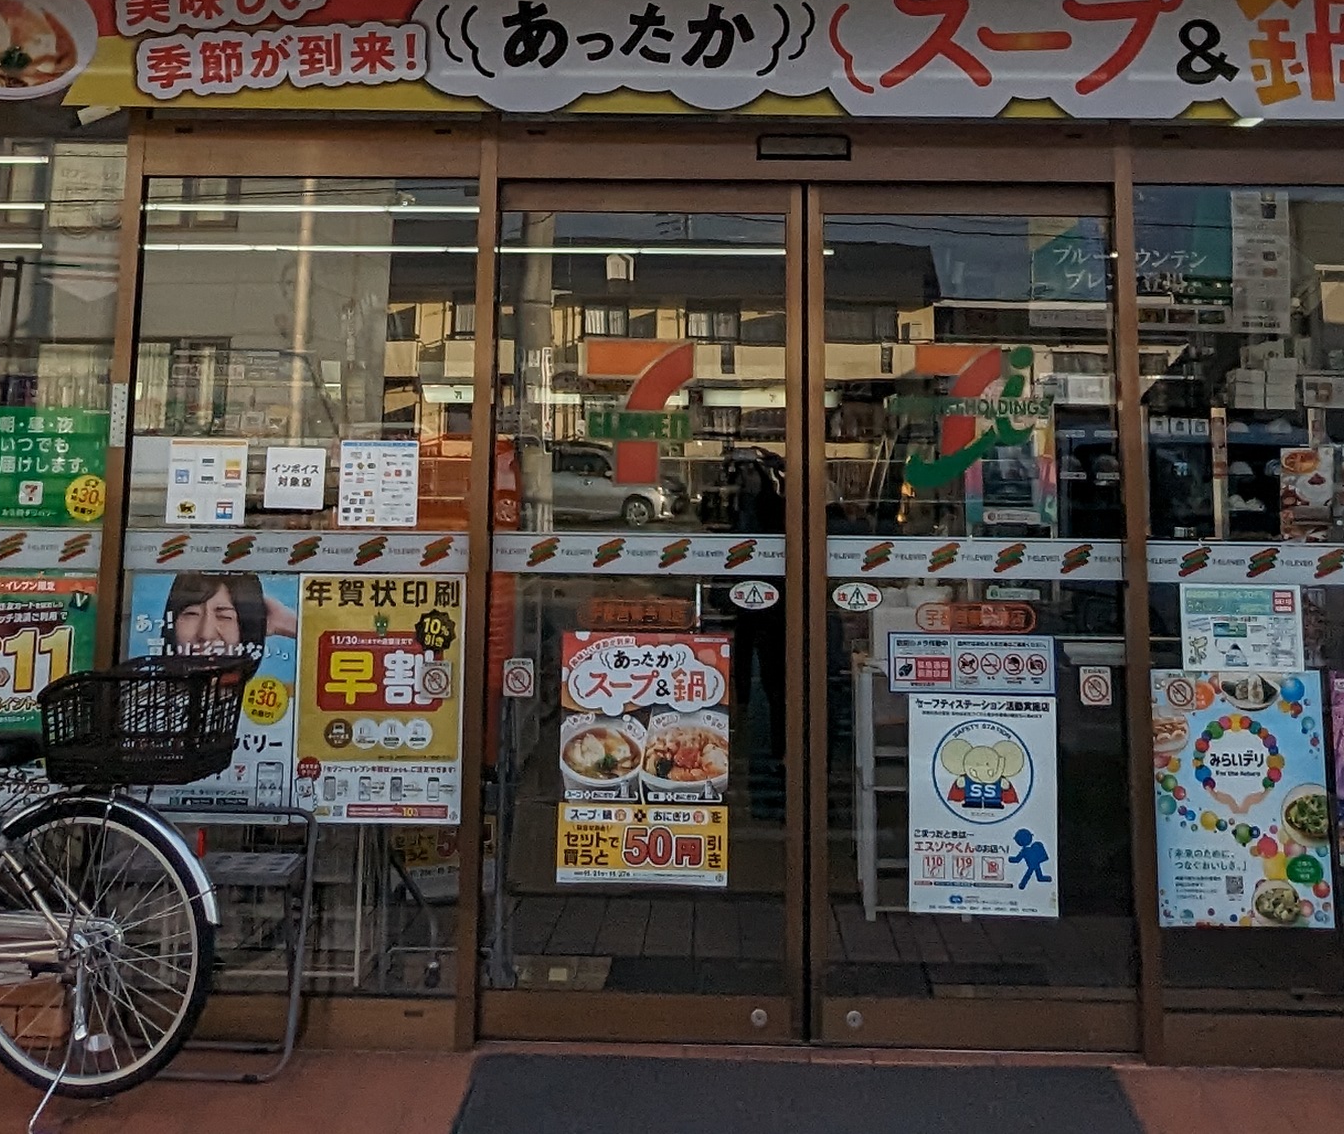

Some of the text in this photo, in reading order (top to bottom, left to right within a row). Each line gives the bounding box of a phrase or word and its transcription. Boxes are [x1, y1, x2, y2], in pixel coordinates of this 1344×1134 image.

[503, 1, 753, 70] あったか
[145, 29, 419, 92] 季節が到来!
[0, 437, 69, 453] いつでも
[306, 579, 460, 608] 年賀状印刷
[613, 650, 674, 670] あったか
[1209, 750, 1264, 768] みらいデリ
[970, 784, 996, 798] SS
[653, 810, 691, 822] おにぎり
[564, 831, 619, 848] セットで
[623, 826, 704, 868] 50円
[564, 849, 609, 866] 買うと
[925, 856, 943, 867] 110
